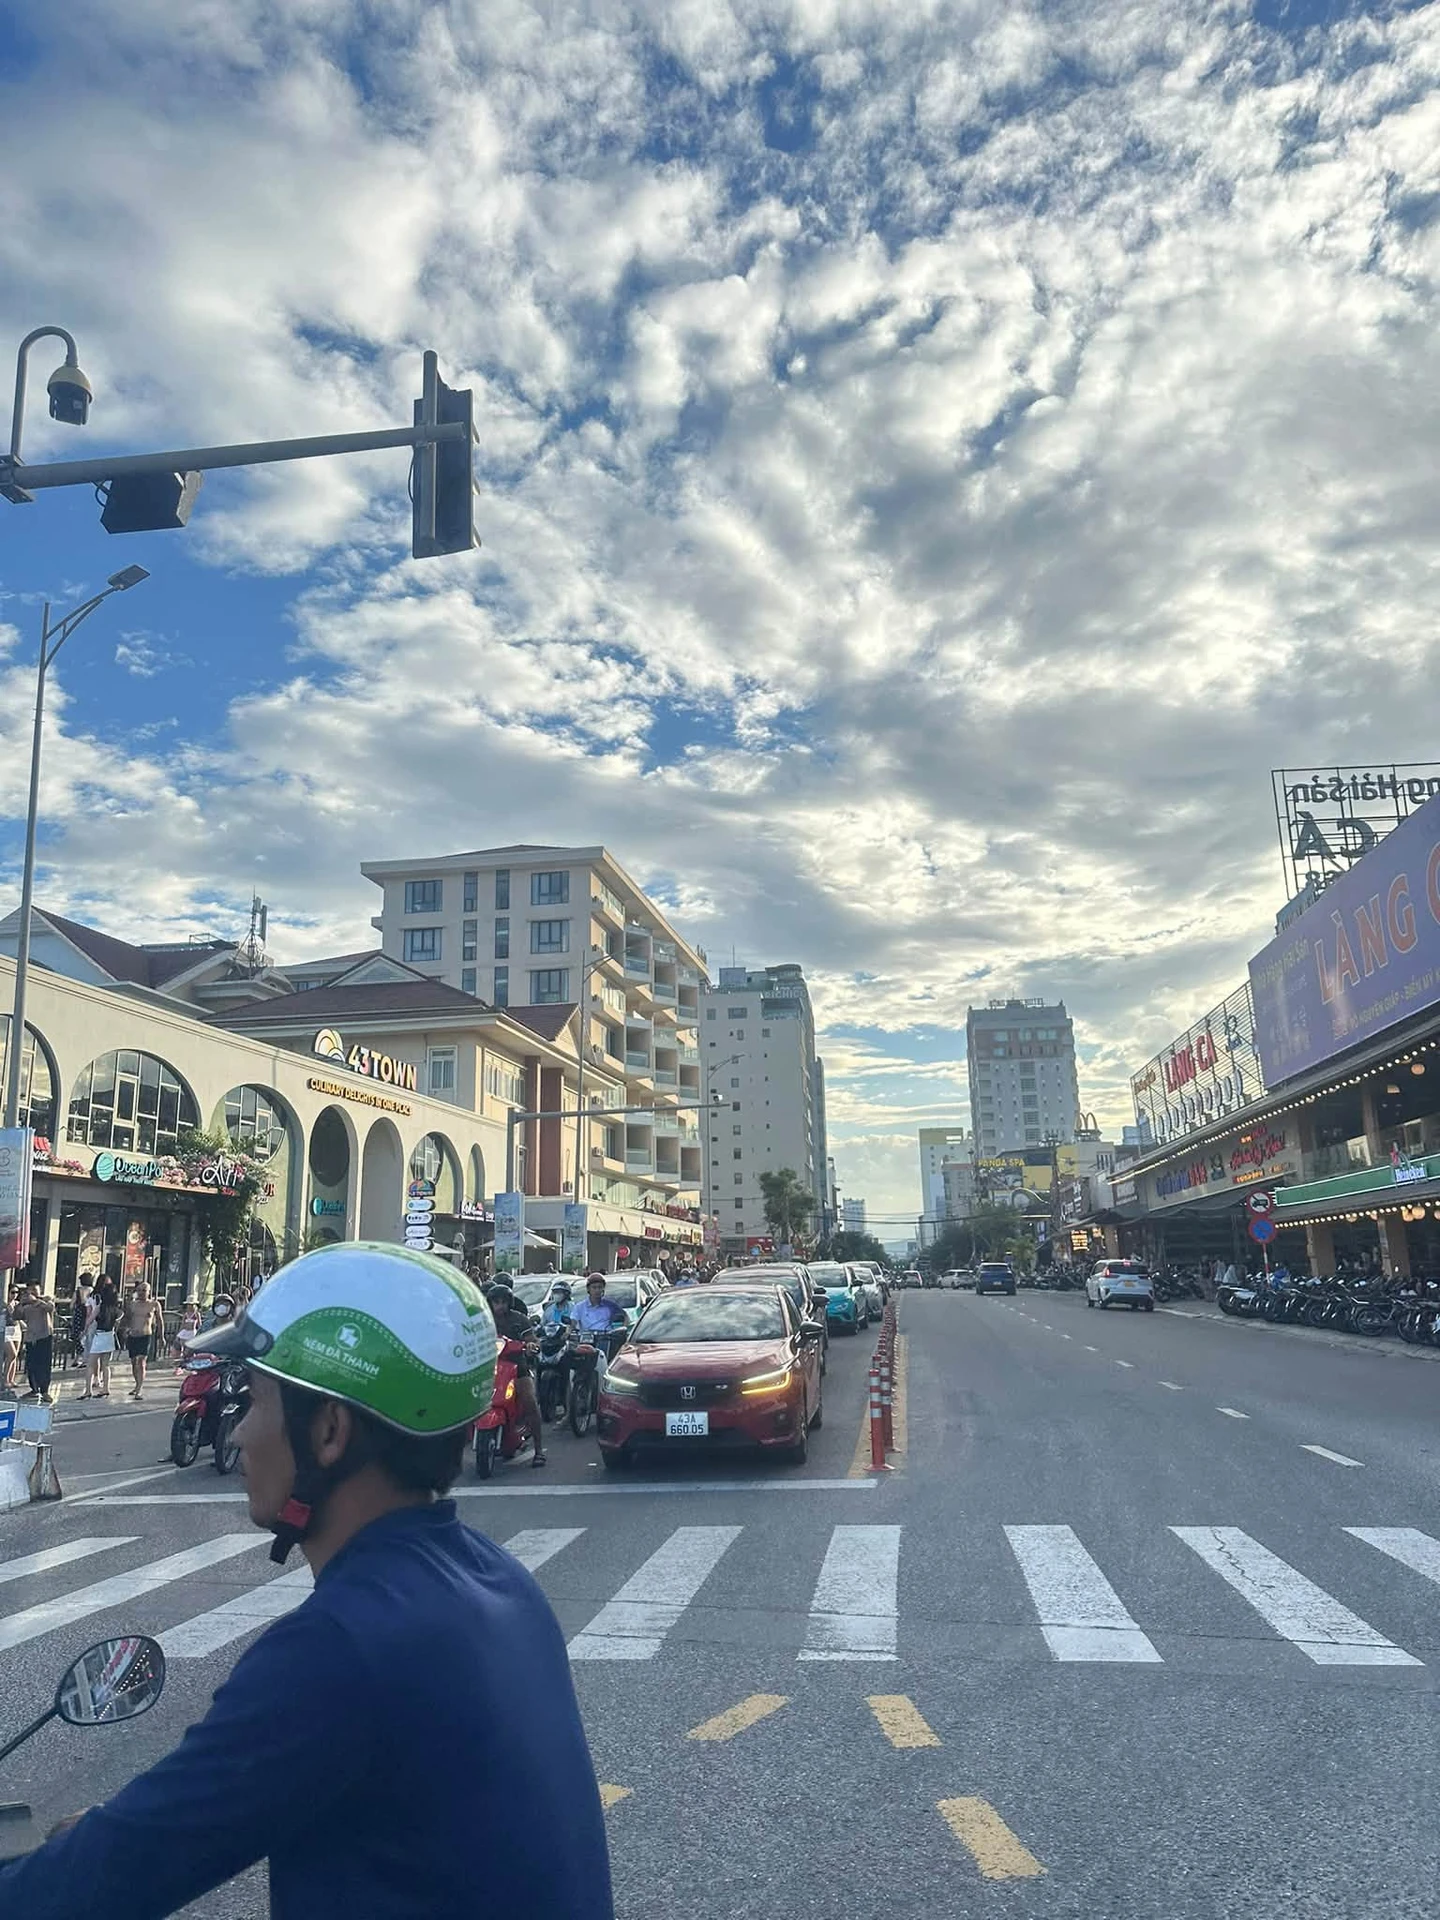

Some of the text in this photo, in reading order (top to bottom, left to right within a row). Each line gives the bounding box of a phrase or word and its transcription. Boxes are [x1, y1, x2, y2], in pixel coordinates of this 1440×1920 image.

[1314, 873, 1418, 1006] LÀNG
[1009, 1158, 1025, 1167] SPA
[678, 1414, 696, 1423] 43A
